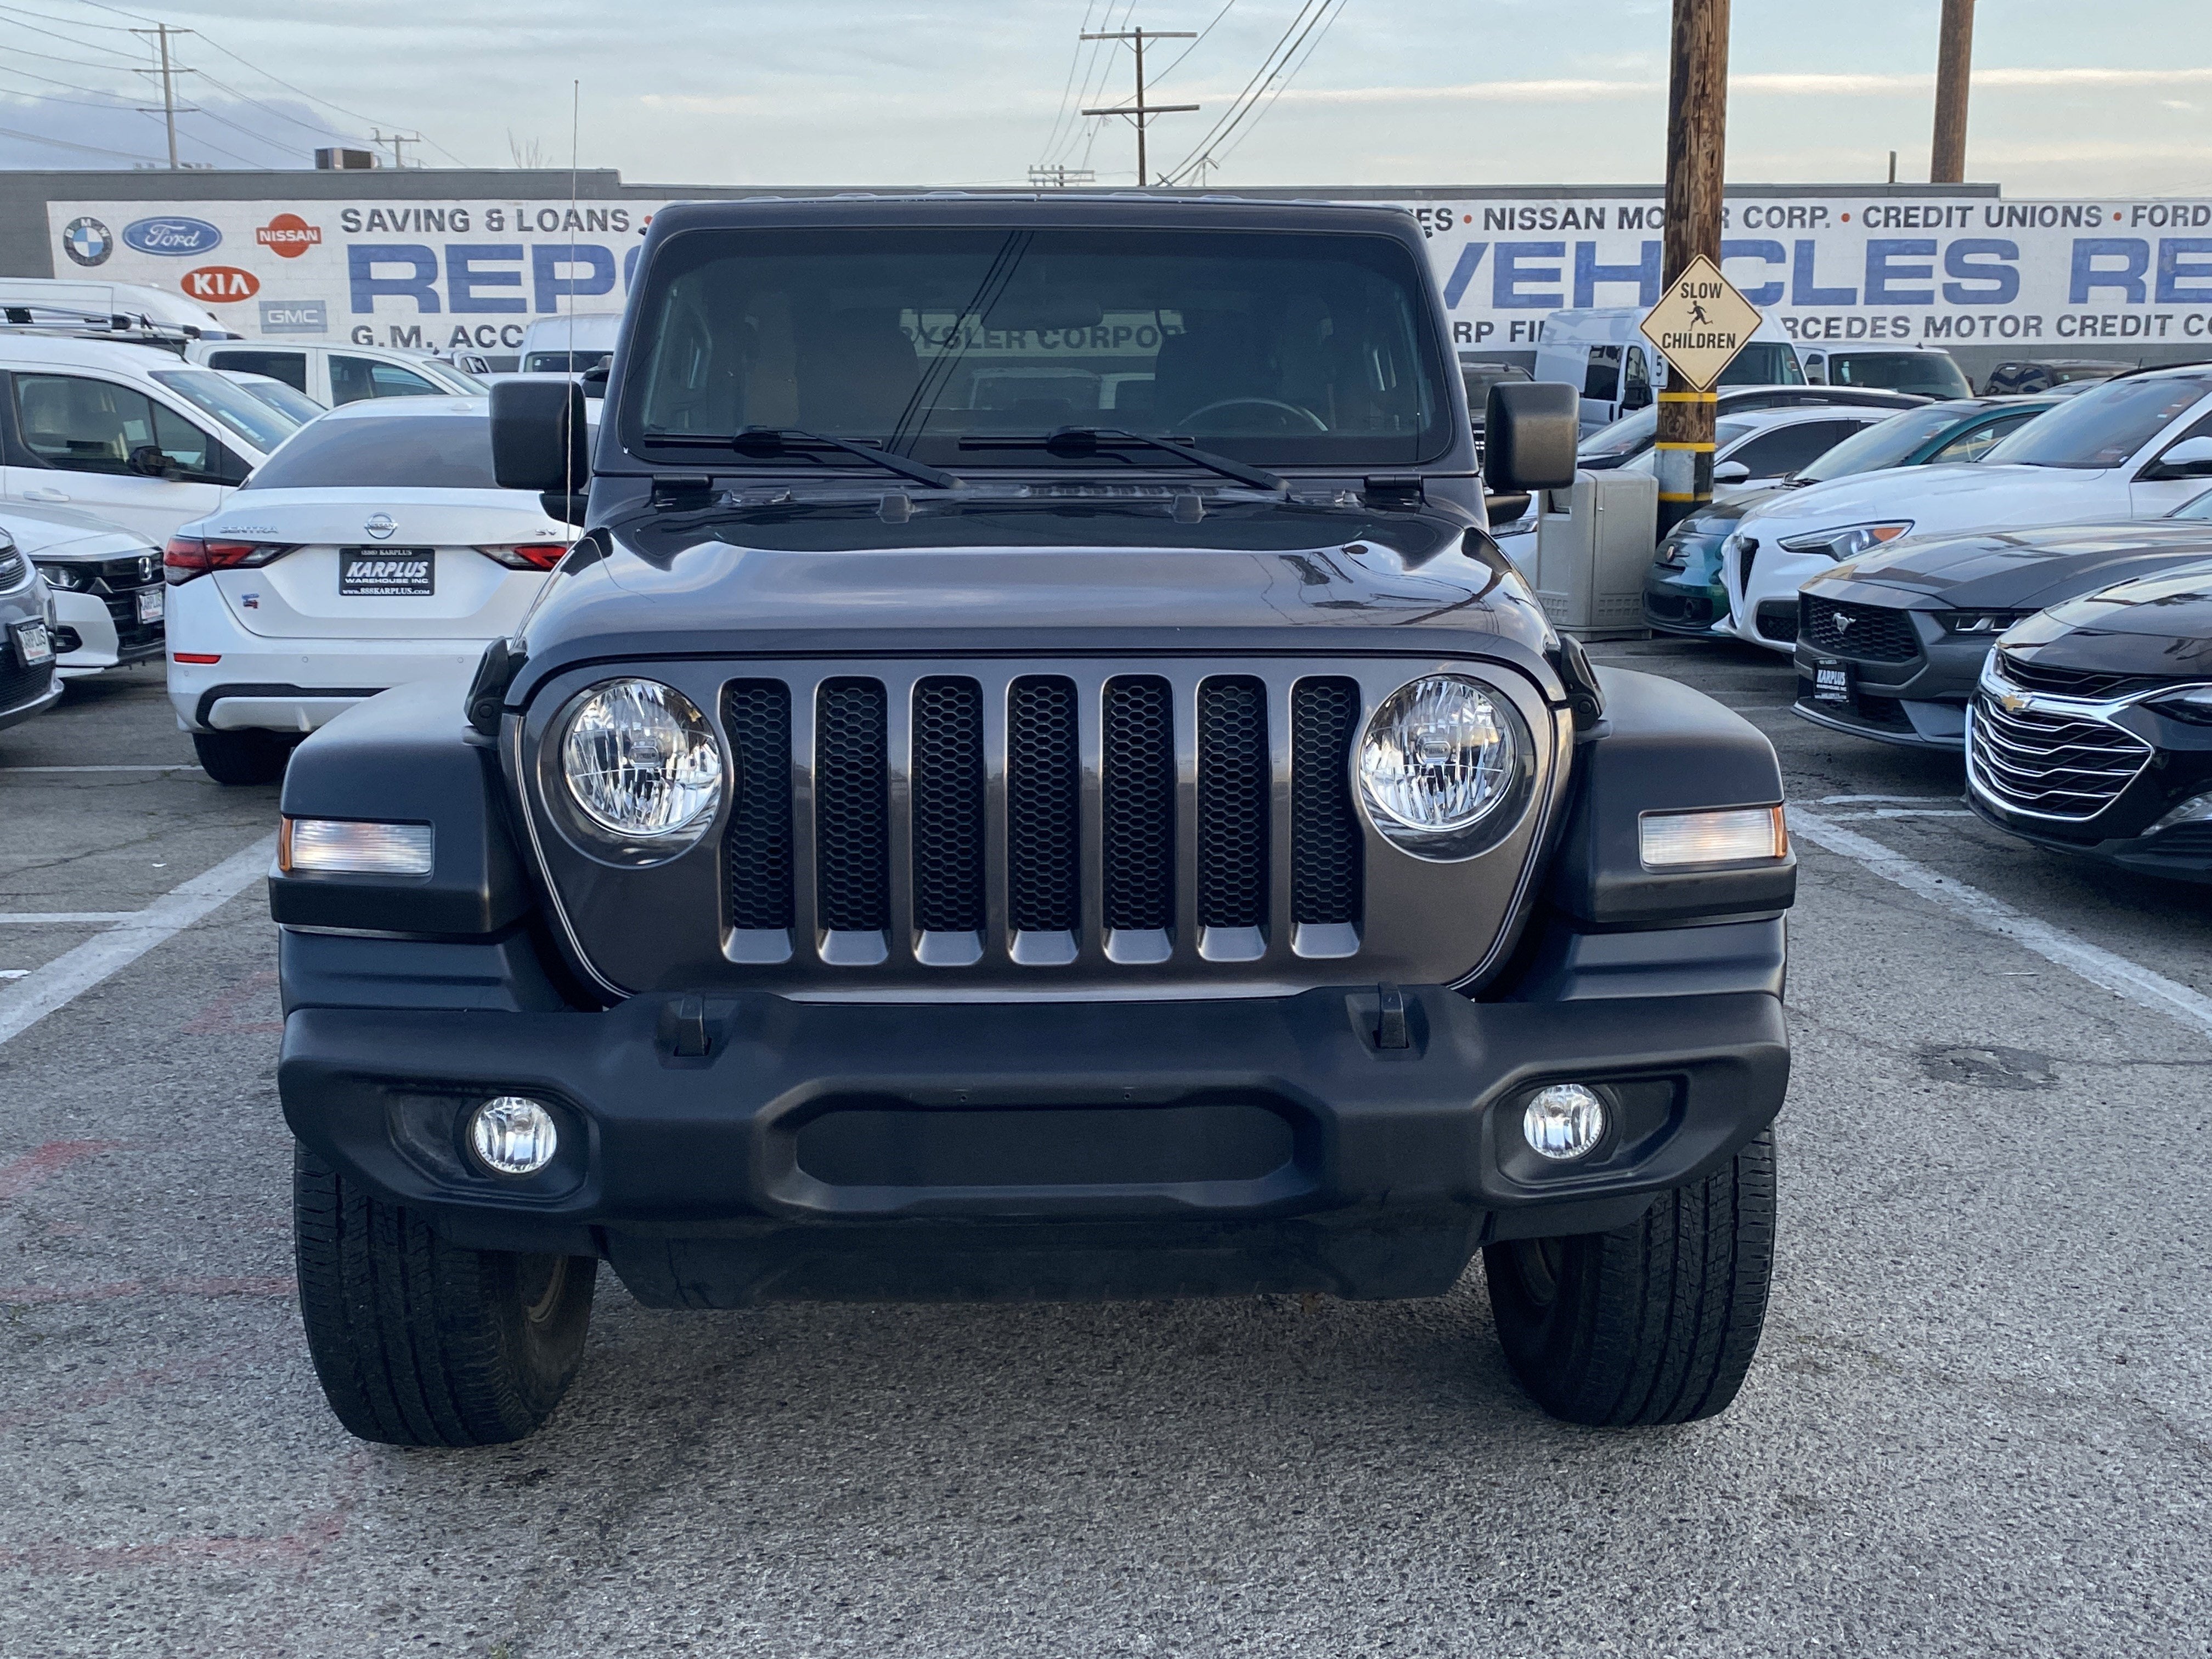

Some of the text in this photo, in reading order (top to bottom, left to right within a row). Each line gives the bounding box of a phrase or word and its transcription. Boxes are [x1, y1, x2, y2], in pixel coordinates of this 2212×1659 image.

[341, 208, 630, 232] SAVING & LOANS
[1408, 207, 1453, 231] ES
[1483, 207, 1605, 230] NISSAN
[1743, 206, 1830, 229] CORP.
[1862, 205, 2102, 228] CREDIT UNIONS
[2131, 205, 2211, 227] FORD
[145, 224, 199, 248] Ford
[259, 230, 318, 241] NISSAN
[194, 272, 250, 295] KIA
[1443, 238, 2019, 309] VEHCLES
[1680, 282, 1723, 299] SLOW
[268, 310, 318, 323] GMC
[1923, 315, 2043, 338] MOTOR
[2056, 314, 2173, 337] CREDIT
[351, 324, 529, 348] G.M. ACC
[1662, 332, 1736, 349] CHILDREN
[346, 561, 429, 578] KARPLUS
[1817, 670, 1845, 686] KARPLUS
